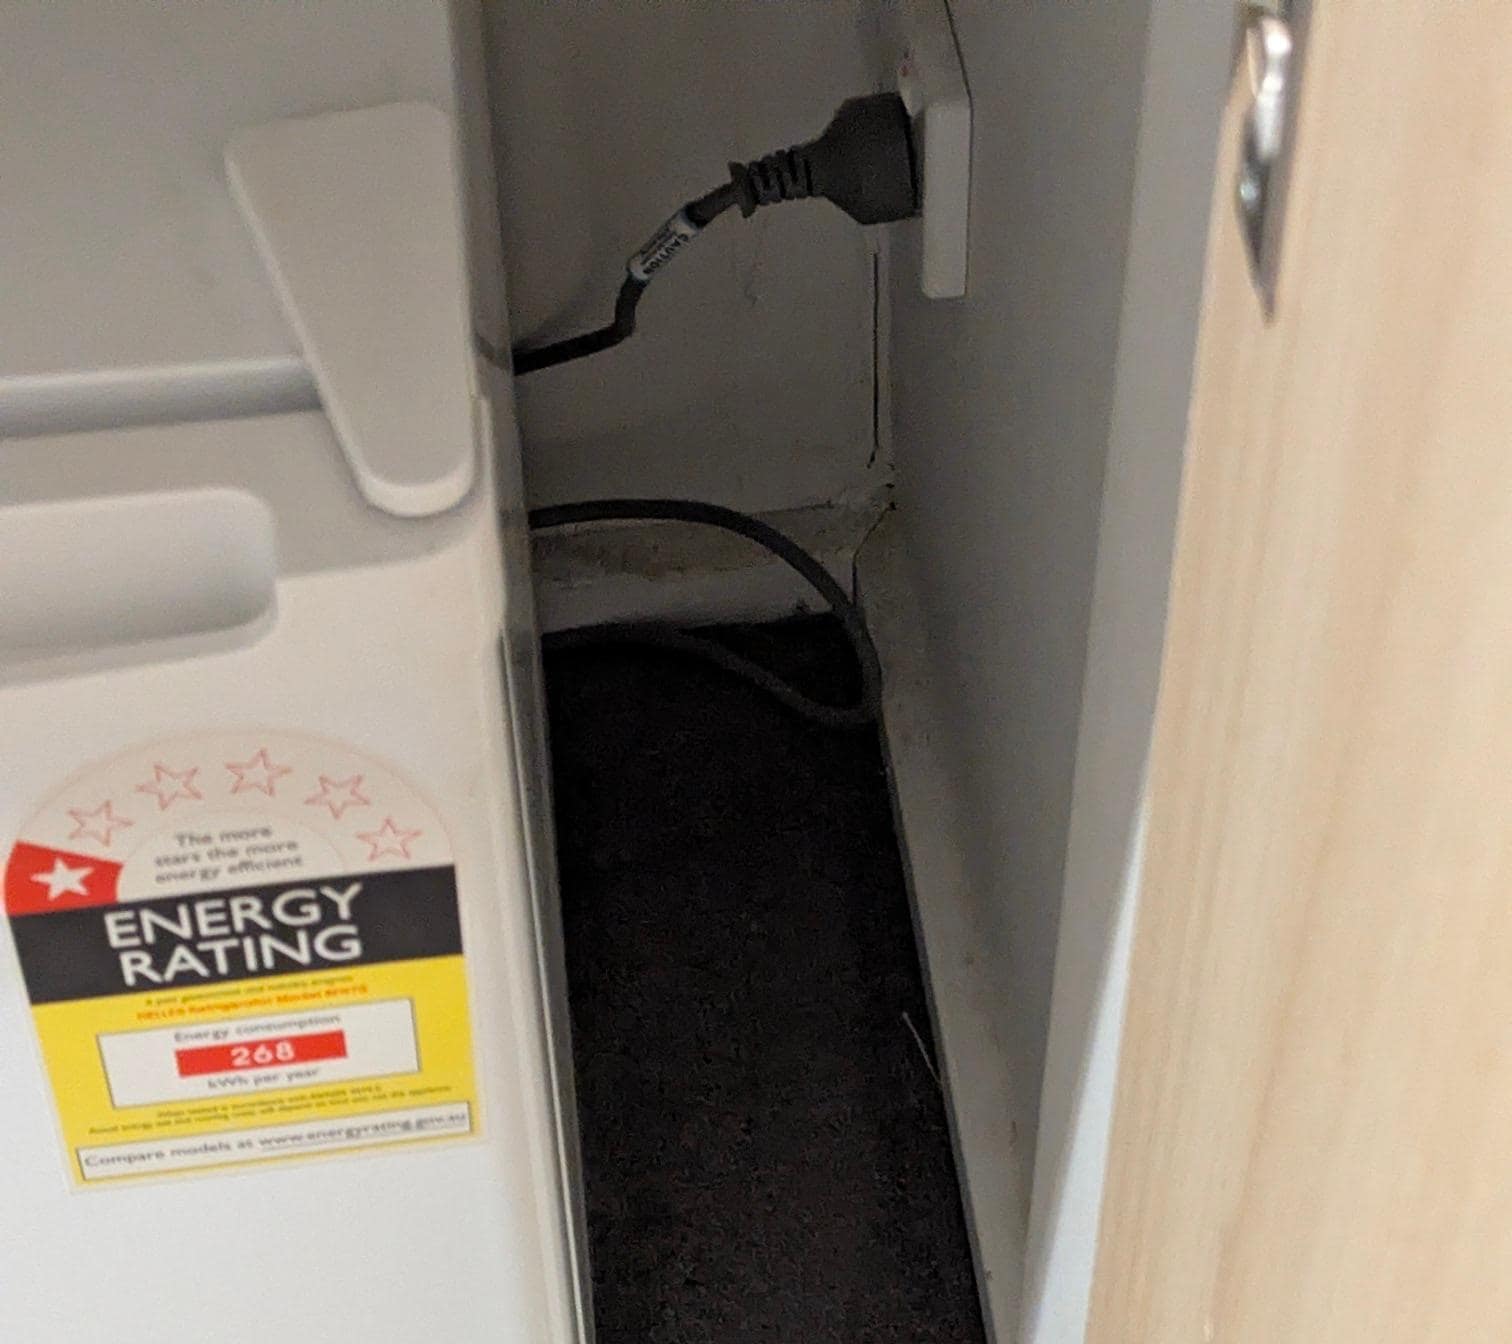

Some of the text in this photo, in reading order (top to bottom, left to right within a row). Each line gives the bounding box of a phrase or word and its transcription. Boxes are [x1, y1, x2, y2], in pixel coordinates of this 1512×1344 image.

[175, 826, 272, 847] The more
[154, 840, 298, 867] stars the more
[154, 855, 303, 883] energy efficient
[103, 883, 363, 949] ENERGY
[119, 924, 363, 987] RATING
[174, 1014, 341, 1042] Energy consumption
[230, 1041, 295, 1067] 268
[208, 1068, 319, 1088] kWh per year
[84, 1150, 165, 1167] Compare
[170, 1141, 231, 1157] models
[237, 1138, 253, 1150] at
